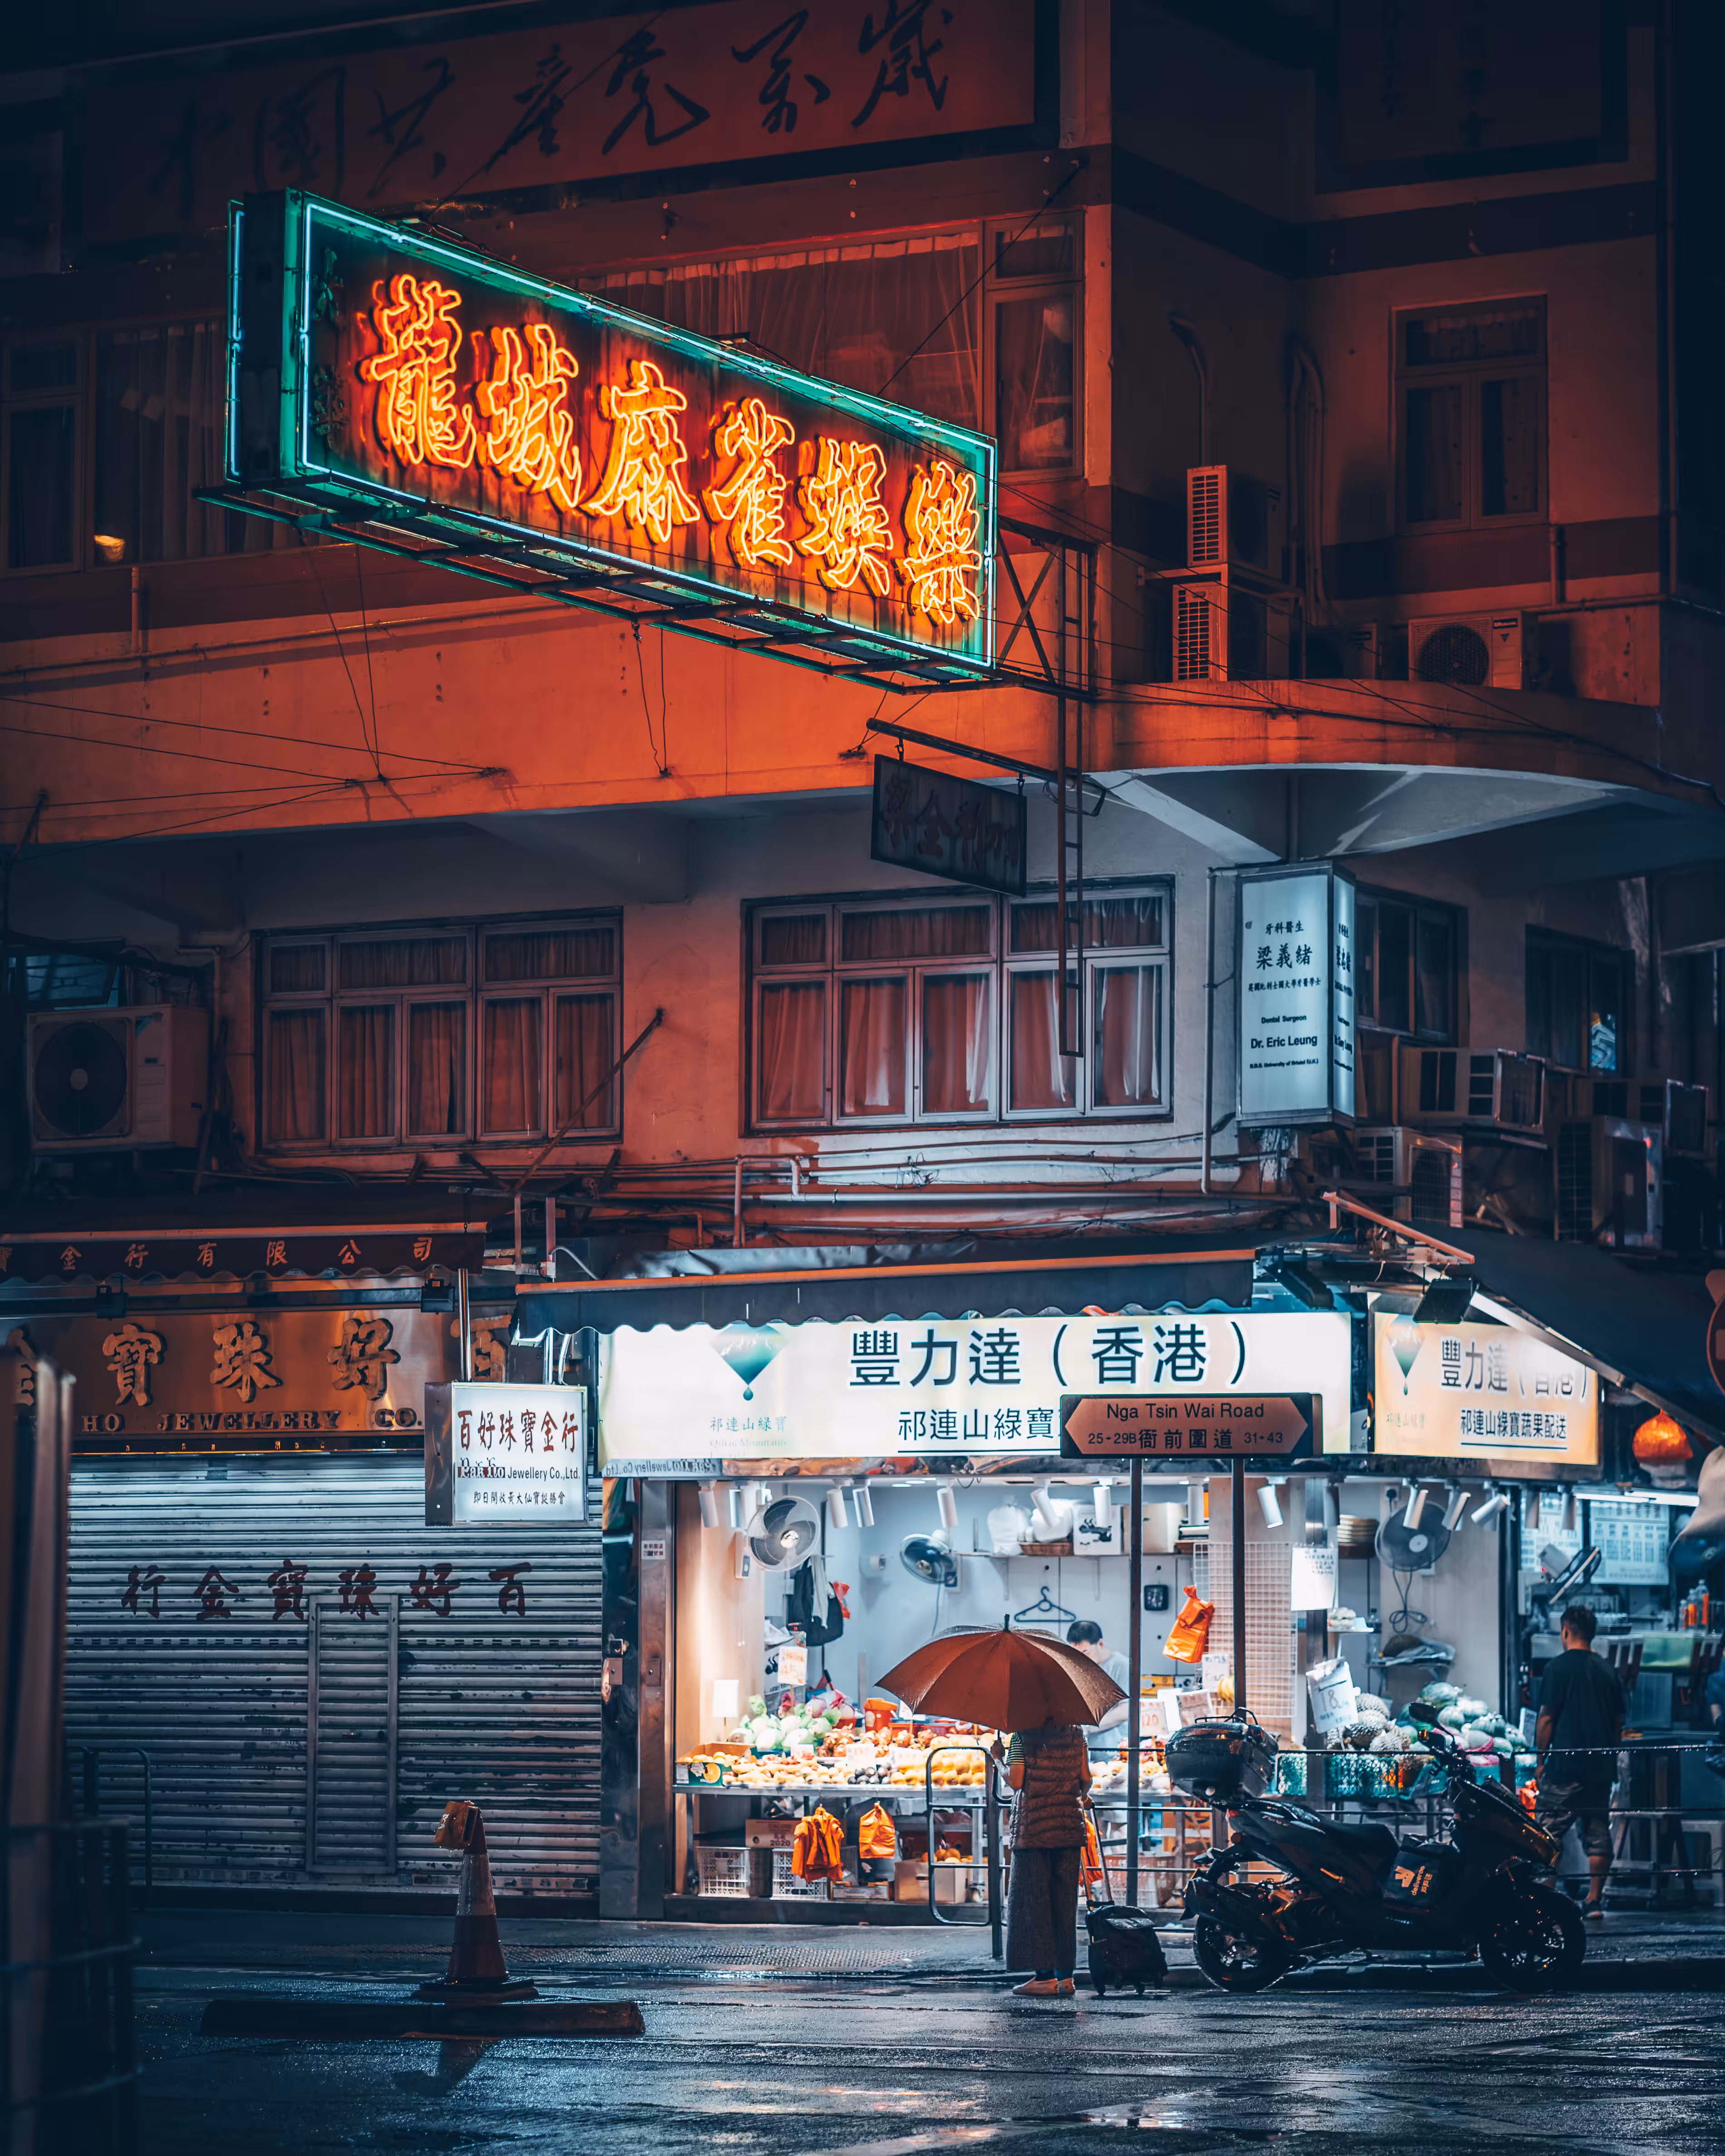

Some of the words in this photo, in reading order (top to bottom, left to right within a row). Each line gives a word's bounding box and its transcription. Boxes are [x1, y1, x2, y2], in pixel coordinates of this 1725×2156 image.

[367, 272, 984, 625] 龍城麻雀娛樂
[1265, 921, 1304, 935] 牙科醫生
[1256, 943, 1313, 970] 梁義緒
[1251, 1038, 1264, 1049] Dr.
[1266, 1036, 1285, 1048] Eric
[1288, 1036, 1318, 1046] Leung
[849, 1321, 1246, 1387] 豐力達（香港）
[82, 1414, 123, 1432] HO
[157, 1410, 341, 1431] JEWELLERY
[375, 1407, 422, 1427] CO.
[898, 1407, 1061, 1440] 祁連山綠寶
[1107, 1403, 1138, 1421] Nga
[1145, 1403, 1177, 1418] Tsin
[1184, 1403, 1215, 1418] Wai
[1220, 1403, 1264, 1418] Road
[457, 1409, 578, 1453] 百好珠寶金行
[1138, 1429, 1233, 1449] 衙前圍道
[508, 1466, 547, 1481] Jewellery
[1411, 1866, 1425, 1896] deliveroo
